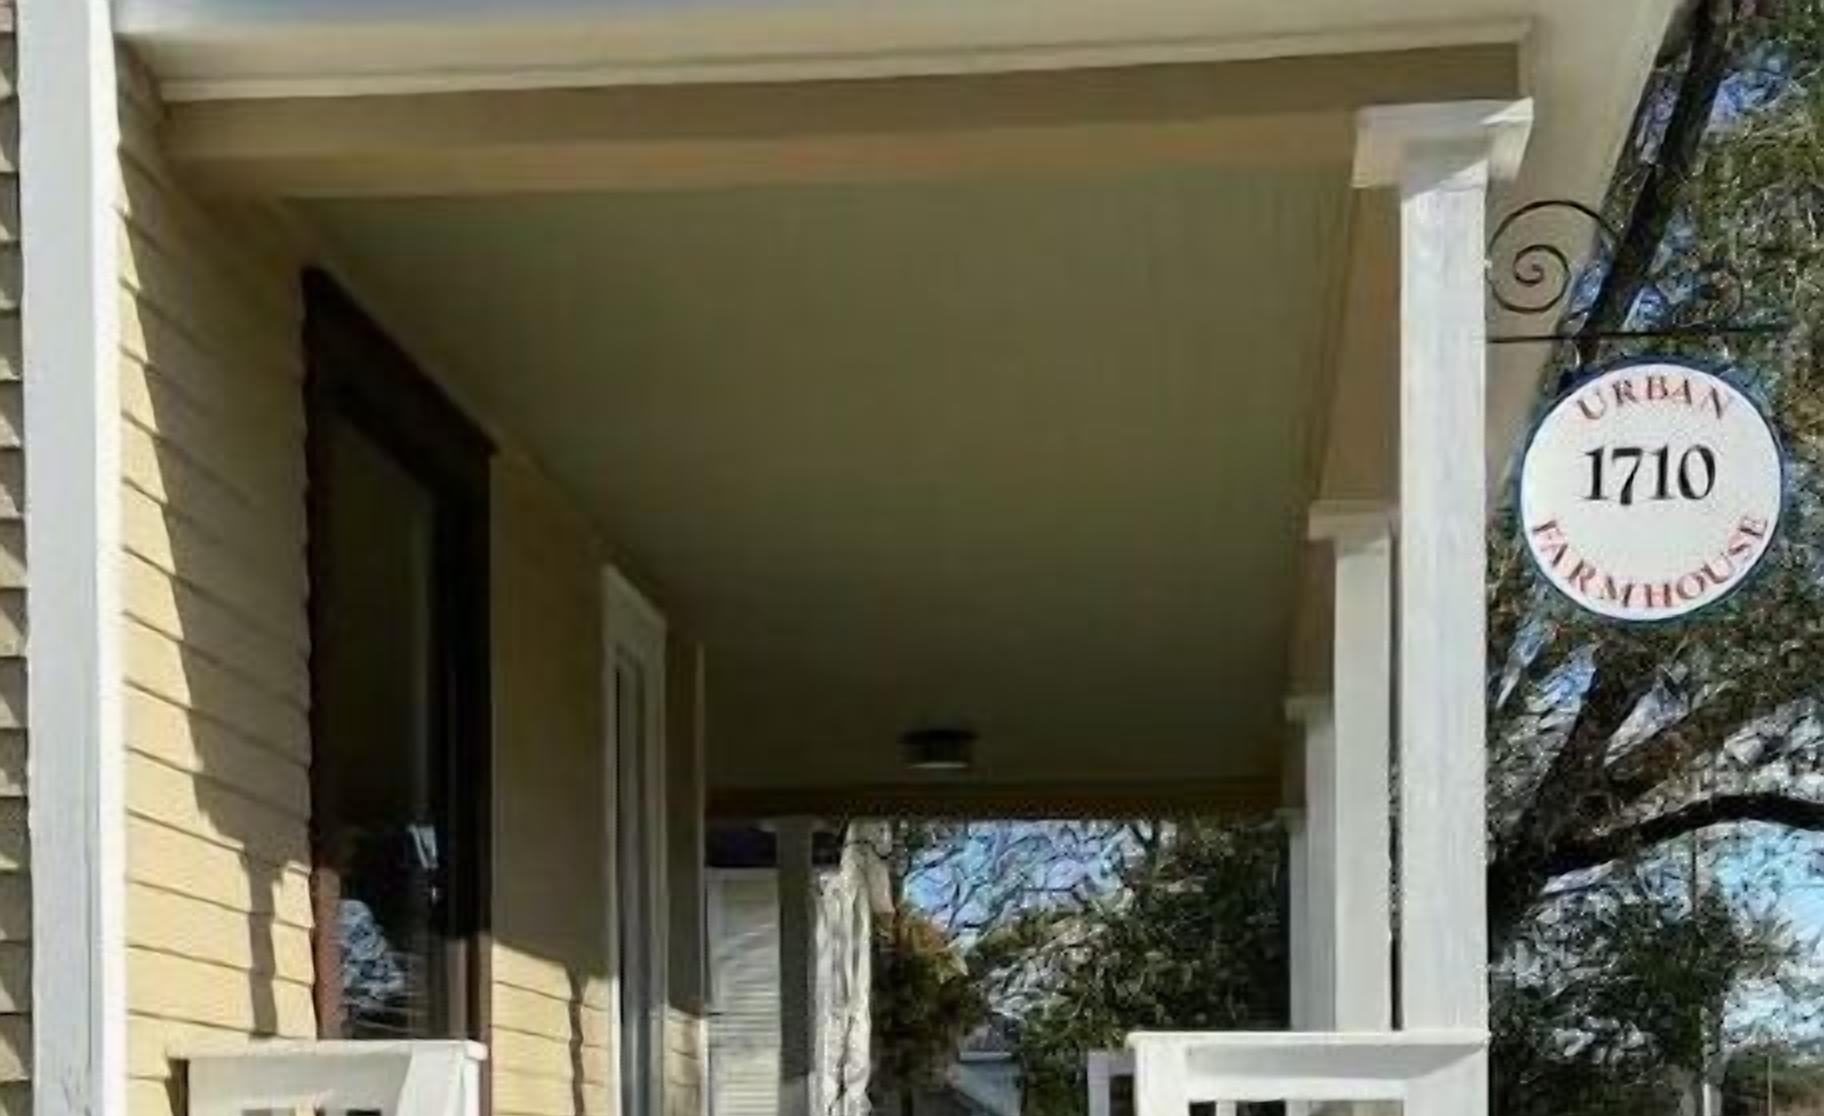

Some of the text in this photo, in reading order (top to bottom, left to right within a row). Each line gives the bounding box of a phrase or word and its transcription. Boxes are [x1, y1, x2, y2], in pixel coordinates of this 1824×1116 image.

[1576, 375, 1731, 420] URBAN
[1581, 443, 1717, 506] 1710
[1532, 516, 1769, 608] FARMHOUSE
